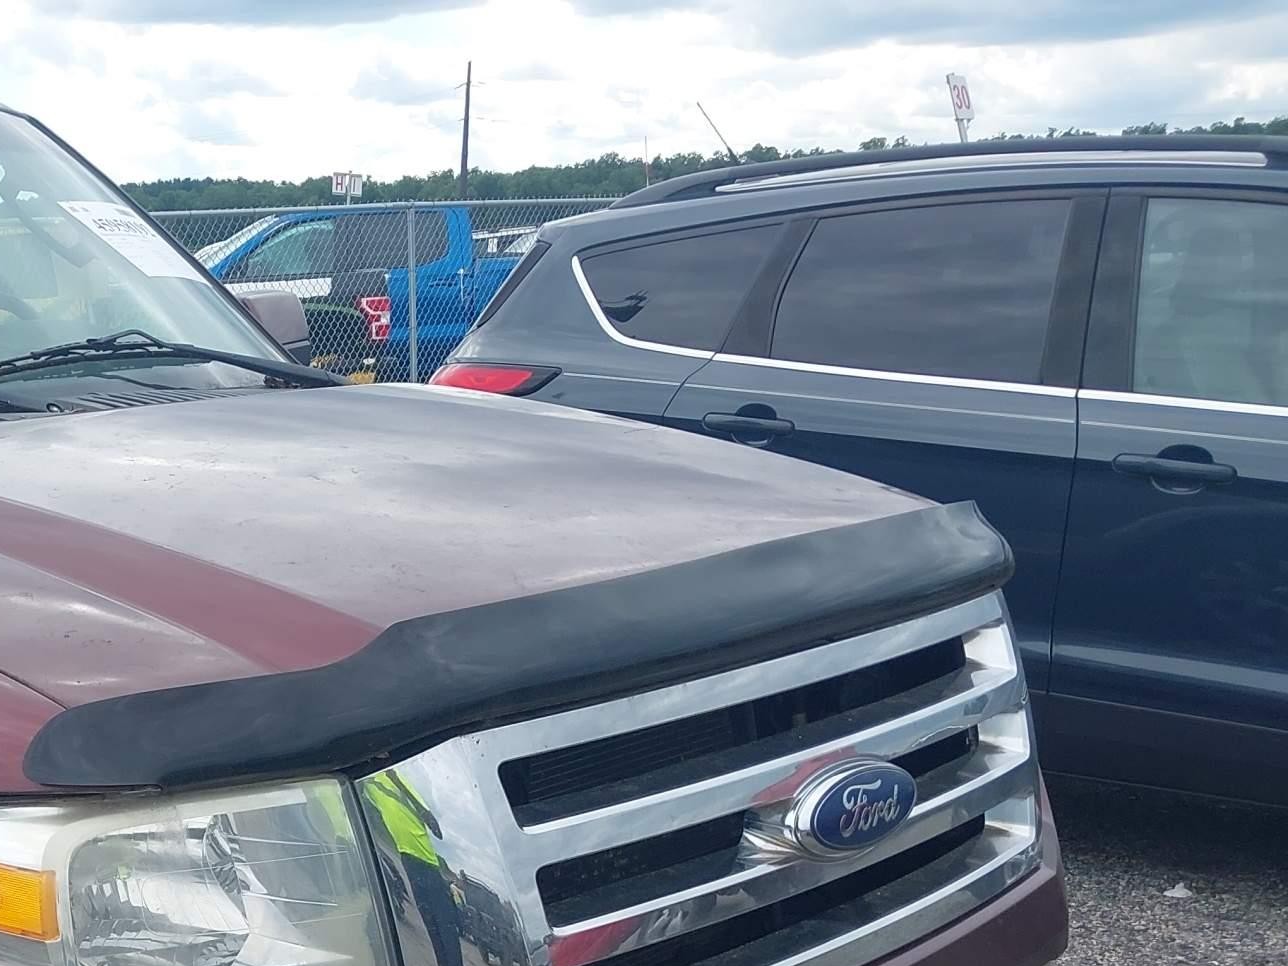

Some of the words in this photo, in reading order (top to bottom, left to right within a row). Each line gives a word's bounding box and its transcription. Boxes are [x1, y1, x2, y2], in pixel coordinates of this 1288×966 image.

[952, 84, 971, 110] 30
[335, 175, 344, 192] H
[839, 778, 900, 838] Ford
